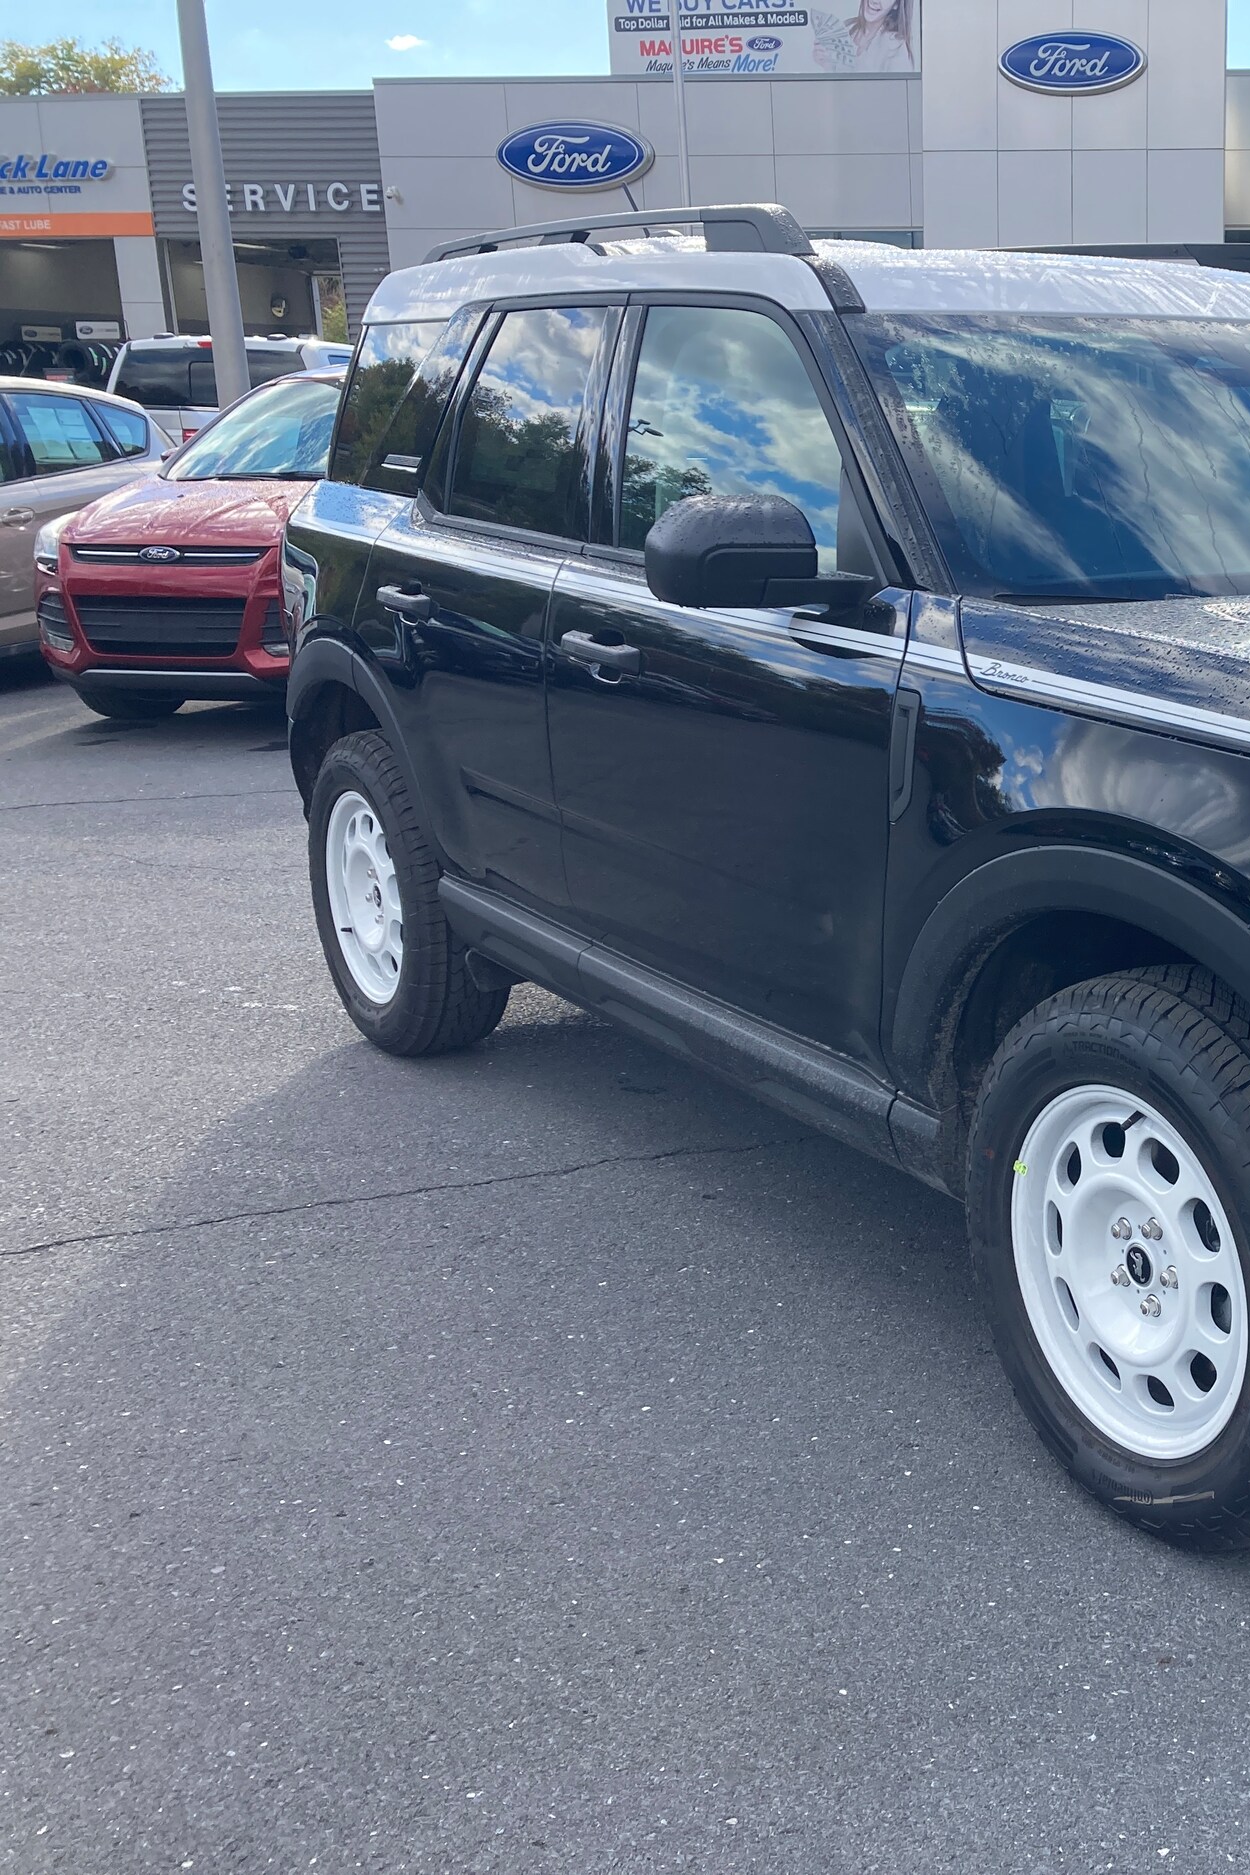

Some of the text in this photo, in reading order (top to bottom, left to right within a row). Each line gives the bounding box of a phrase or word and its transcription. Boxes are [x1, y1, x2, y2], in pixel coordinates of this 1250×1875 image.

[626, 0, 661, 13] WE
[619, 19, 637, 30] Top
[639, 18, 668, 29] Dollar
[692, 16, 707, 27] for
[708, 15, 722, 26] All
[723, 14, 756, 25] Makes
[757, 14, 766, 24] &
[767, 13, 805, 24] Models
[753, 38, 776, 49] Ford
[697, 57, 731, 69] Means
[731, 53, 779, 72] More!
[1029, 42, 1111, 77] Ford
[527, 134, 612, 173] Ford
[35, 154, 108, 178] Lane
[17, 186, 42, 194] AUTO
[44, 185, 81, 194] CENTER
[23, 219, 51, 230] LUBE
[980, 662, 1029, 683] Bronco
